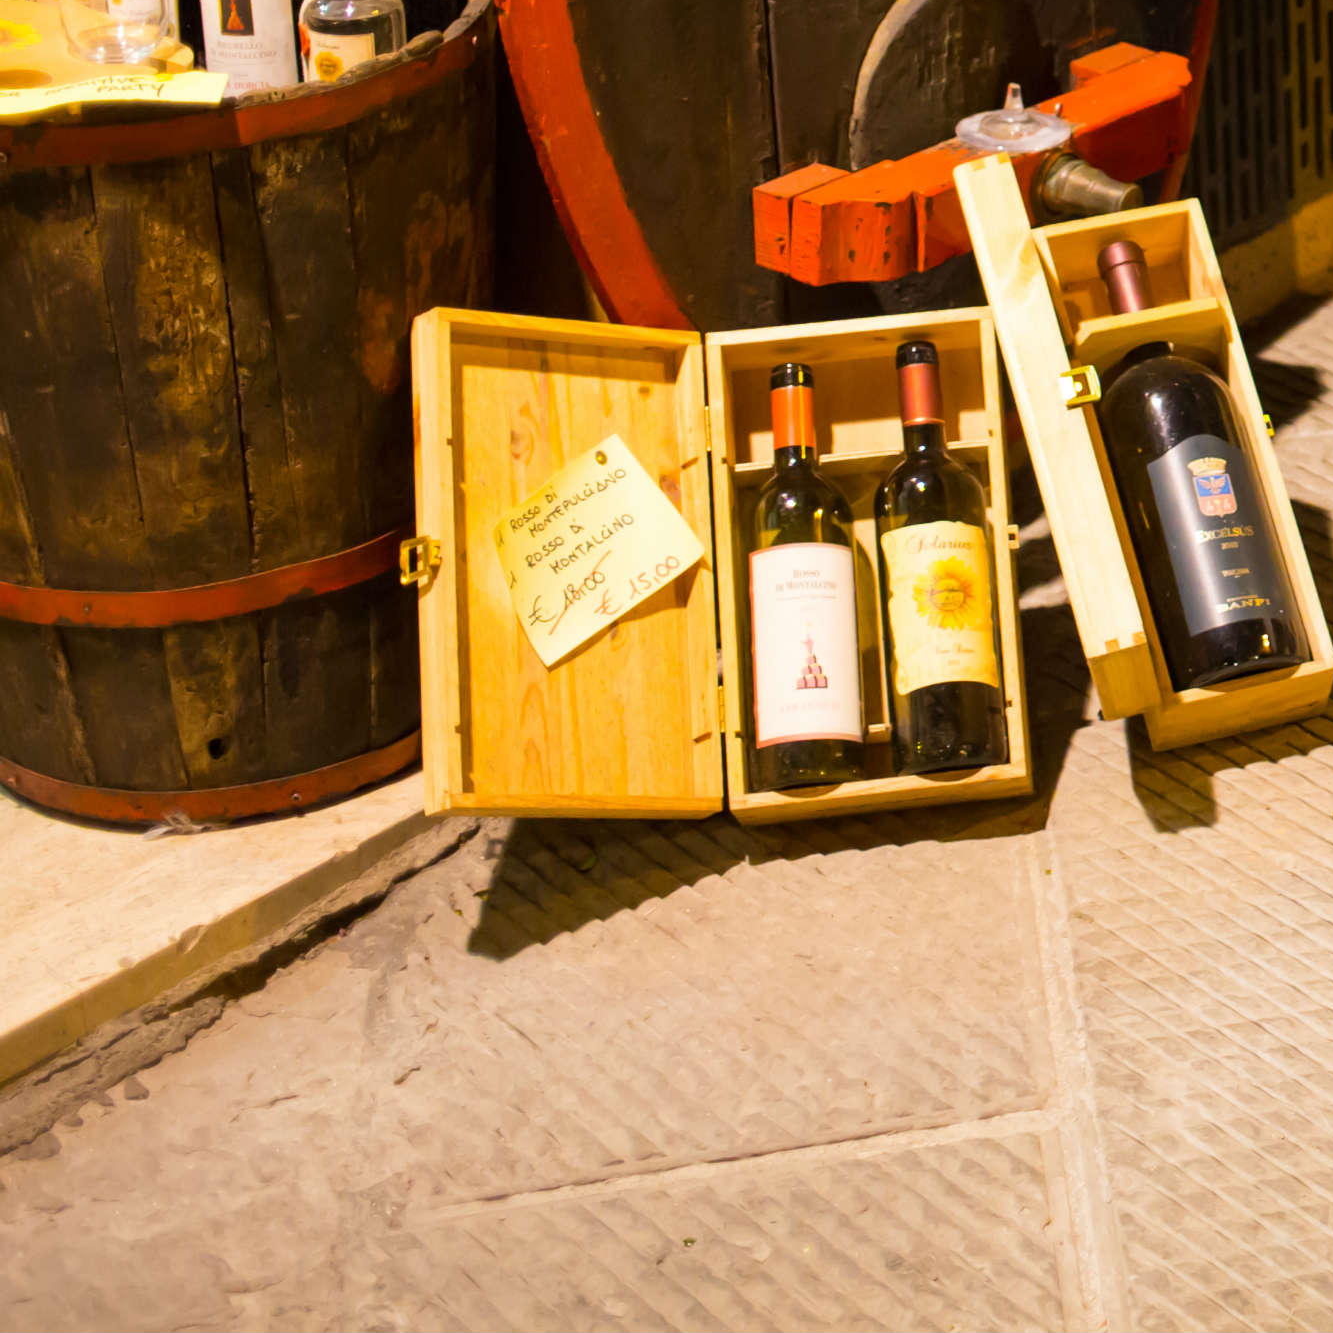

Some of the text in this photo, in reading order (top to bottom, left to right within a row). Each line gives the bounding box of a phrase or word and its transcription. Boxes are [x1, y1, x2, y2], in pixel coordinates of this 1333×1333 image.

[510, 504, 542, 534] ROSSO
[528, 467, 628, 538] MONTEPULCIANO
[525, 534, 566, 569] ROSSO
[548, 512, 636, 575] MONTALCINO
